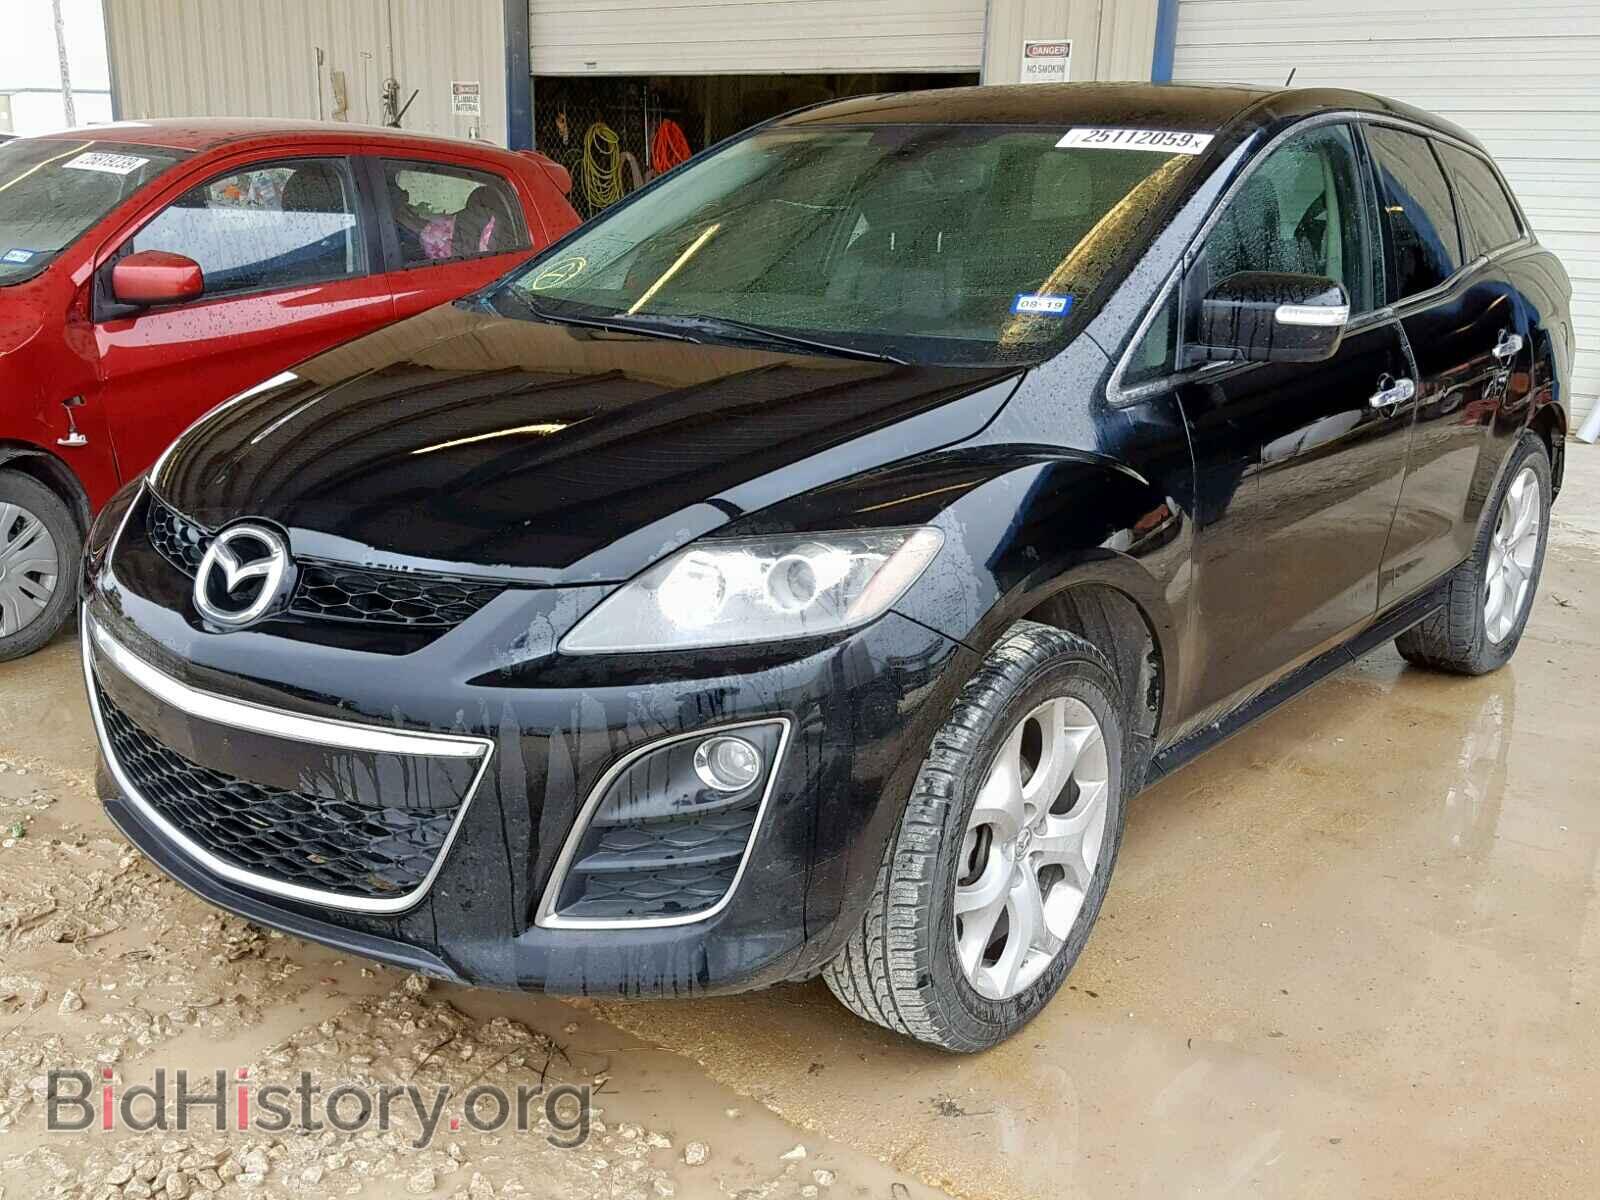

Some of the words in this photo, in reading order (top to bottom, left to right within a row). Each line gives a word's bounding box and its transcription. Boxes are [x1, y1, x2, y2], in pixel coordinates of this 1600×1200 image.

[1031, 46, 1066, 55] DANGER
[1027, 64, 1037, 73] NO
[1038, 64, 1066, 73] SMOKIN
